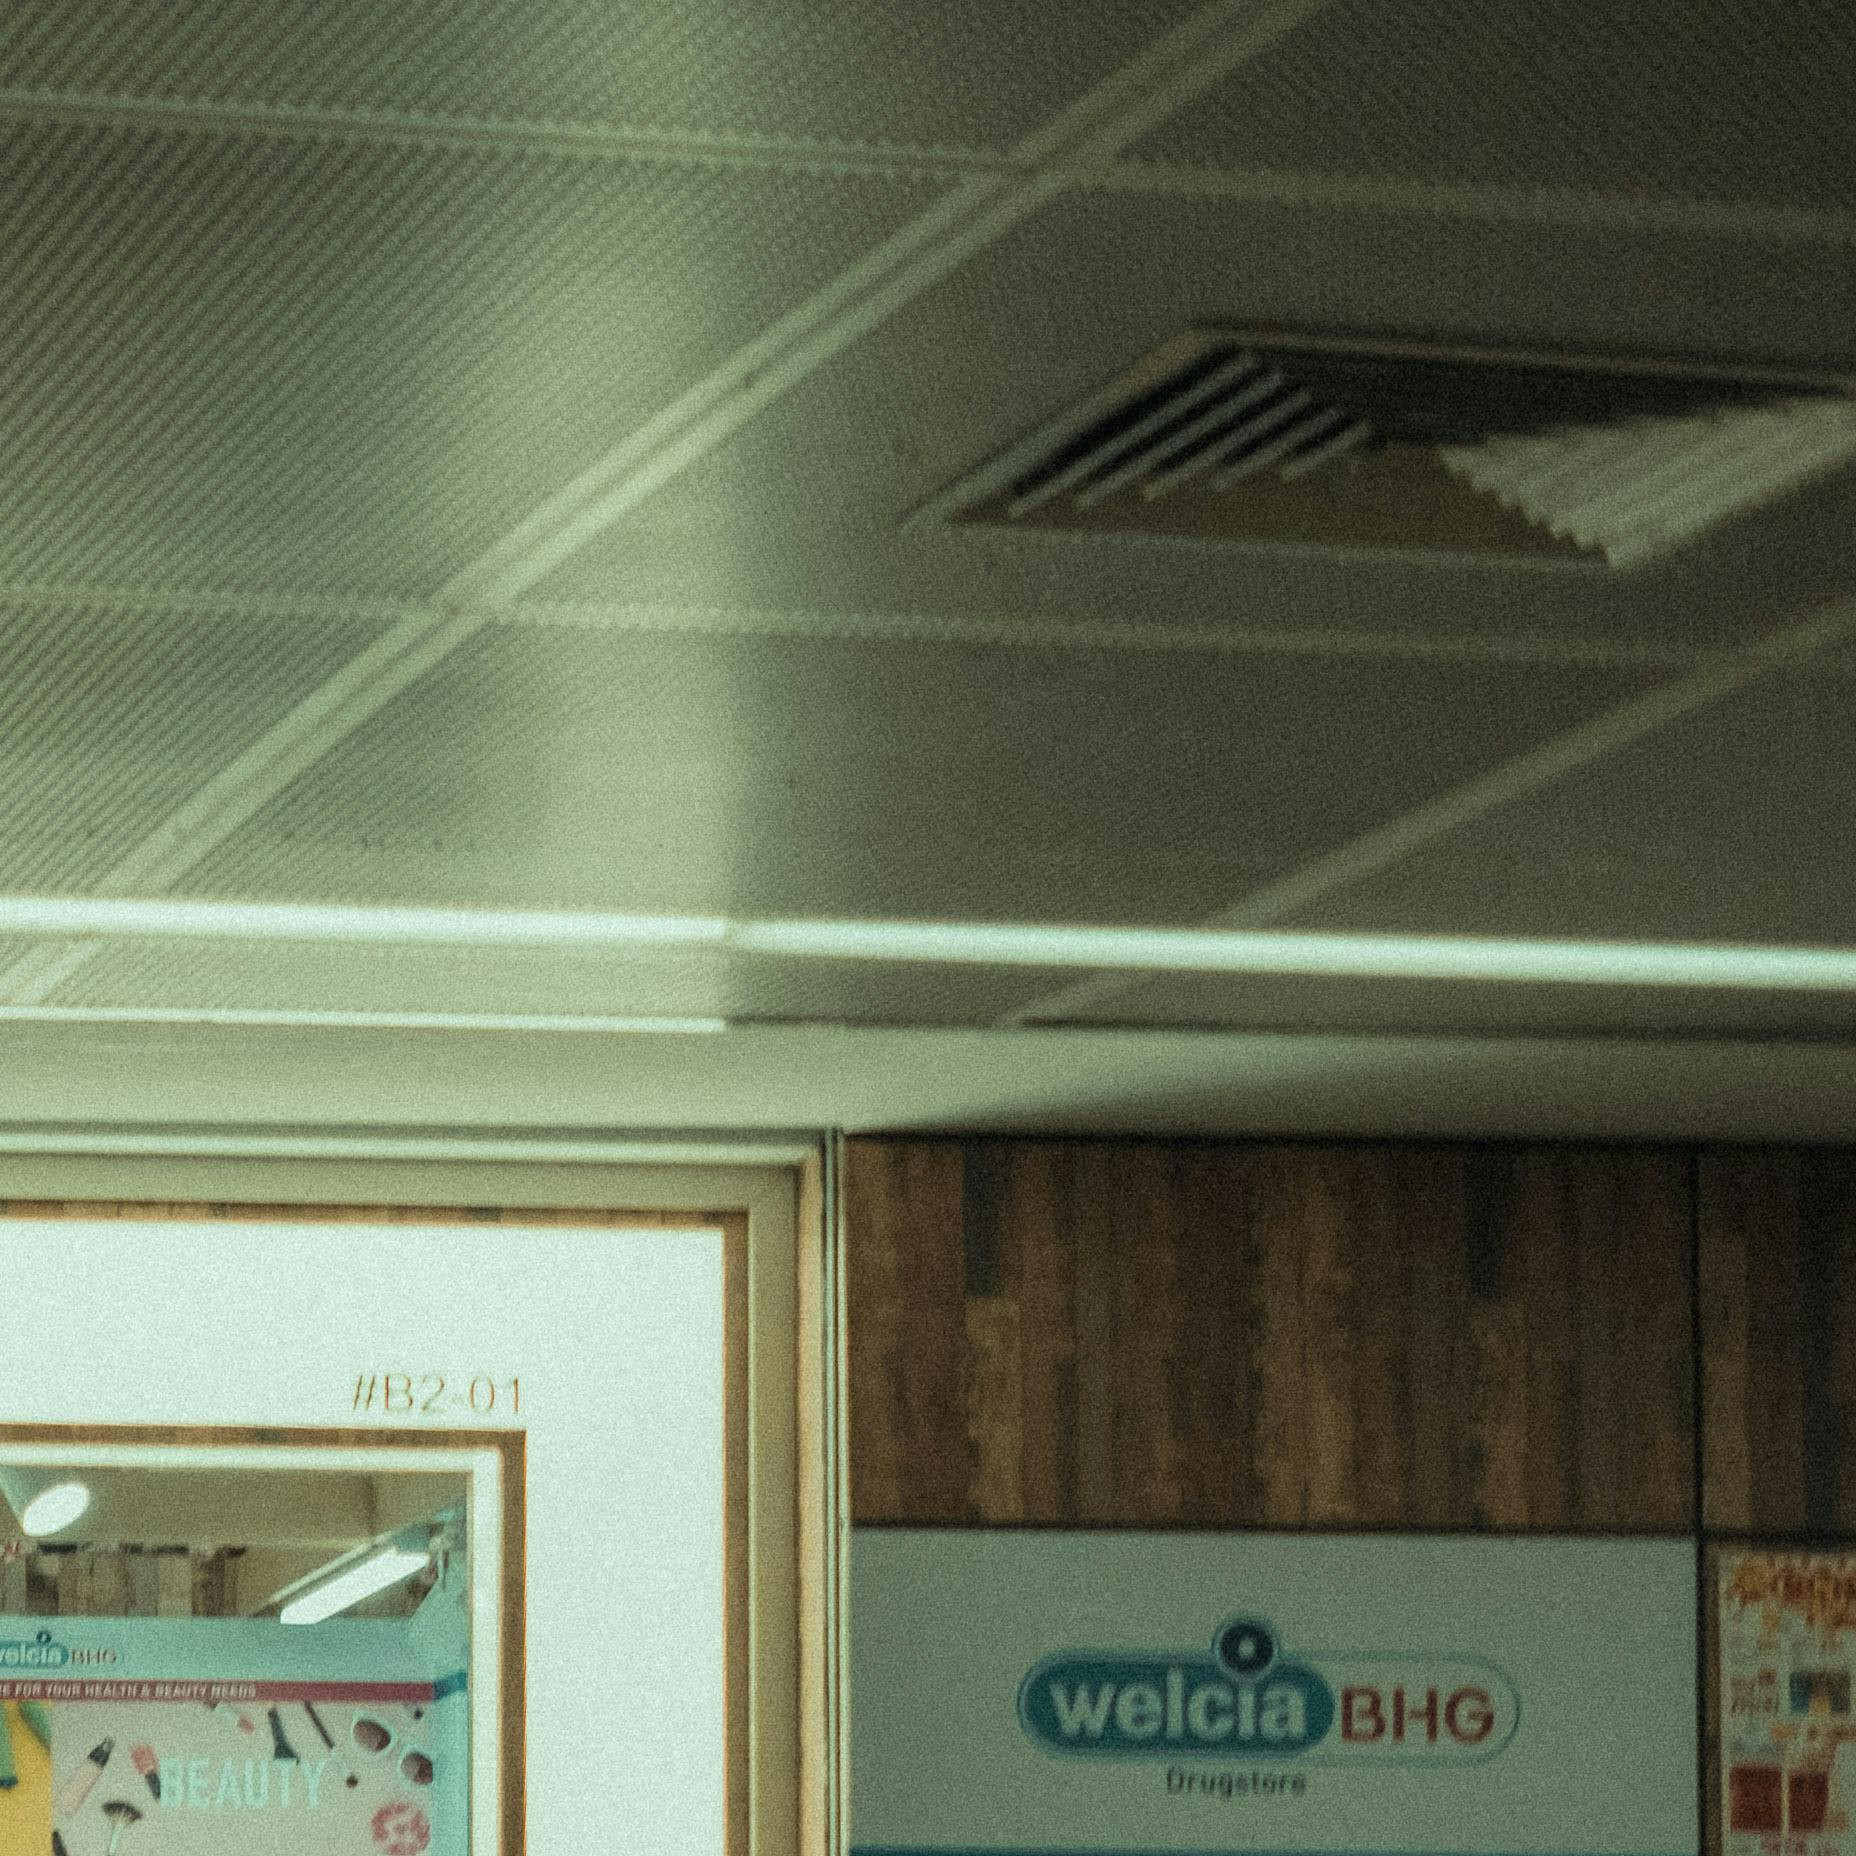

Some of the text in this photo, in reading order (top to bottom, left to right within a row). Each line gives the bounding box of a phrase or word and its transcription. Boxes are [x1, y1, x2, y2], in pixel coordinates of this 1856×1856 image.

[351, 1373, 522, 1414] #B2-01
[1050, 1668, 1496, 1746] welcia BHG
[160, 1755, 326, 1812] BEAUTY
[1166, 1765, 1306, 1799] Drugstore
